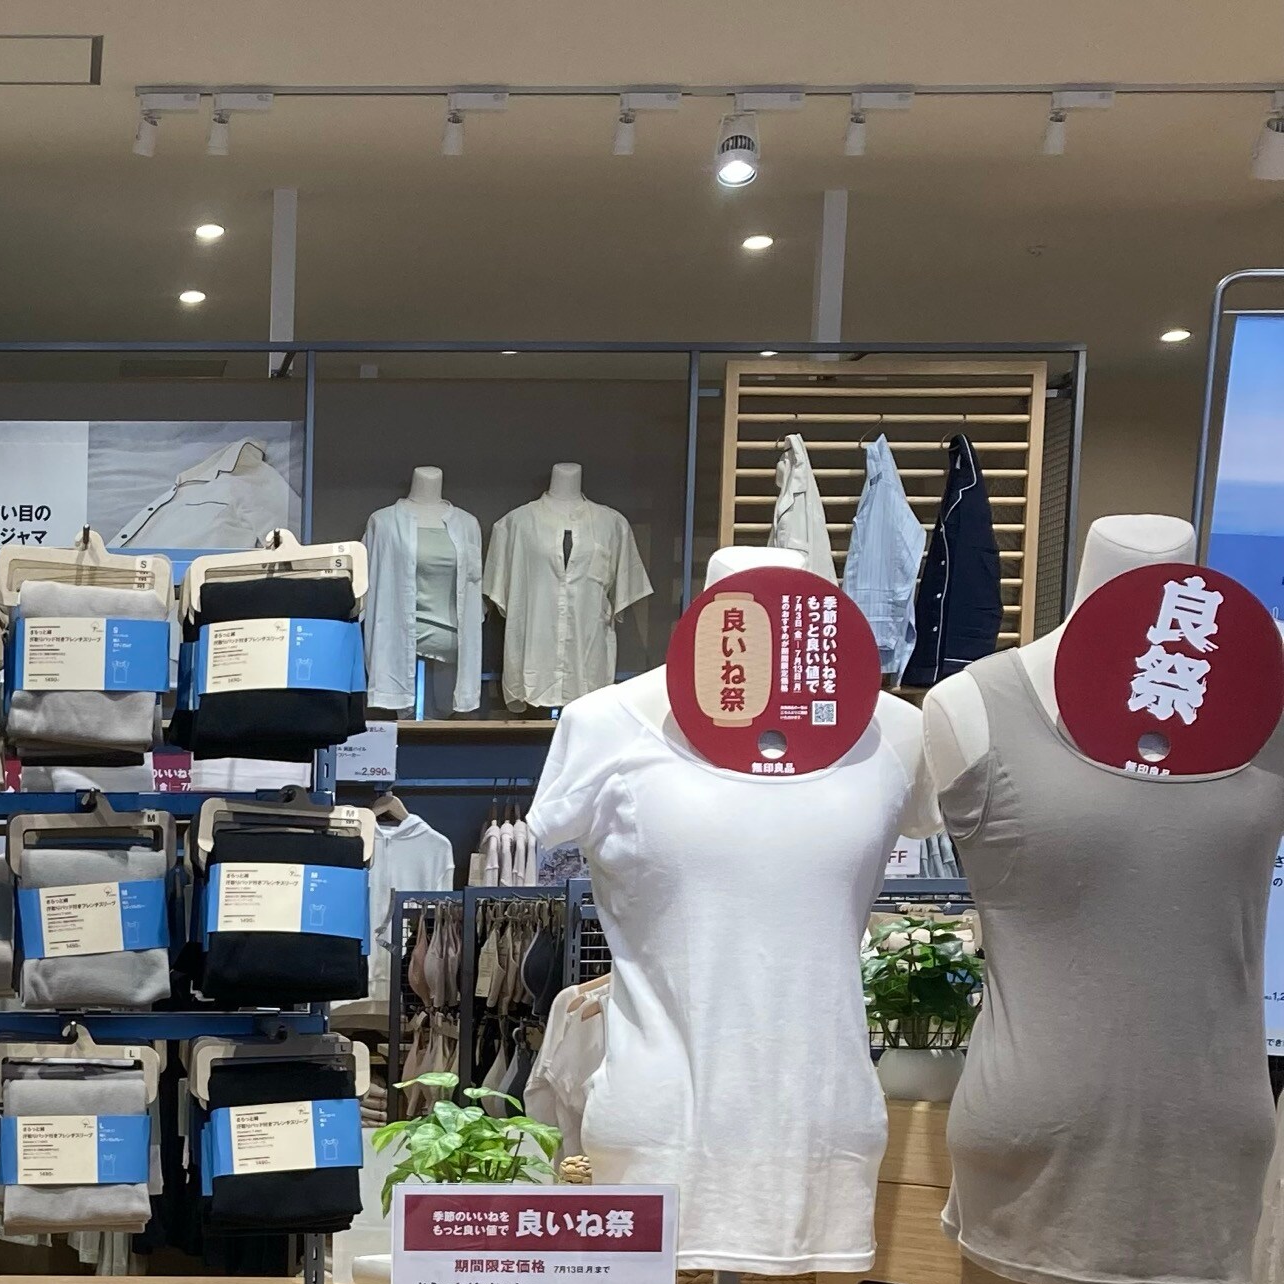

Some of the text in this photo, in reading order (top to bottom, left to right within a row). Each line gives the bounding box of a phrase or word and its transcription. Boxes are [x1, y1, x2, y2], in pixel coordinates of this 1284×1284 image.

[140, 560, 147, 568] S
[335, 559, 342, 567] S
[806, 596, 820, 694] もっと良い値で
[823, 596, 837, 694] 季節のいいねを
[1128, 576, 1224, 725] 良祭
[720, 607, 747, 712] 良いね祭
[752, 762, 795, 774] 無印良品
[433, 1211, 509, 1223] 季節のいいねを
[516, 1209, 634, 1238] 良いね祭
[433, 1225, 509, 1236] もっと良い値で
[455, 1259, 545, 1273] 期間限定価格
